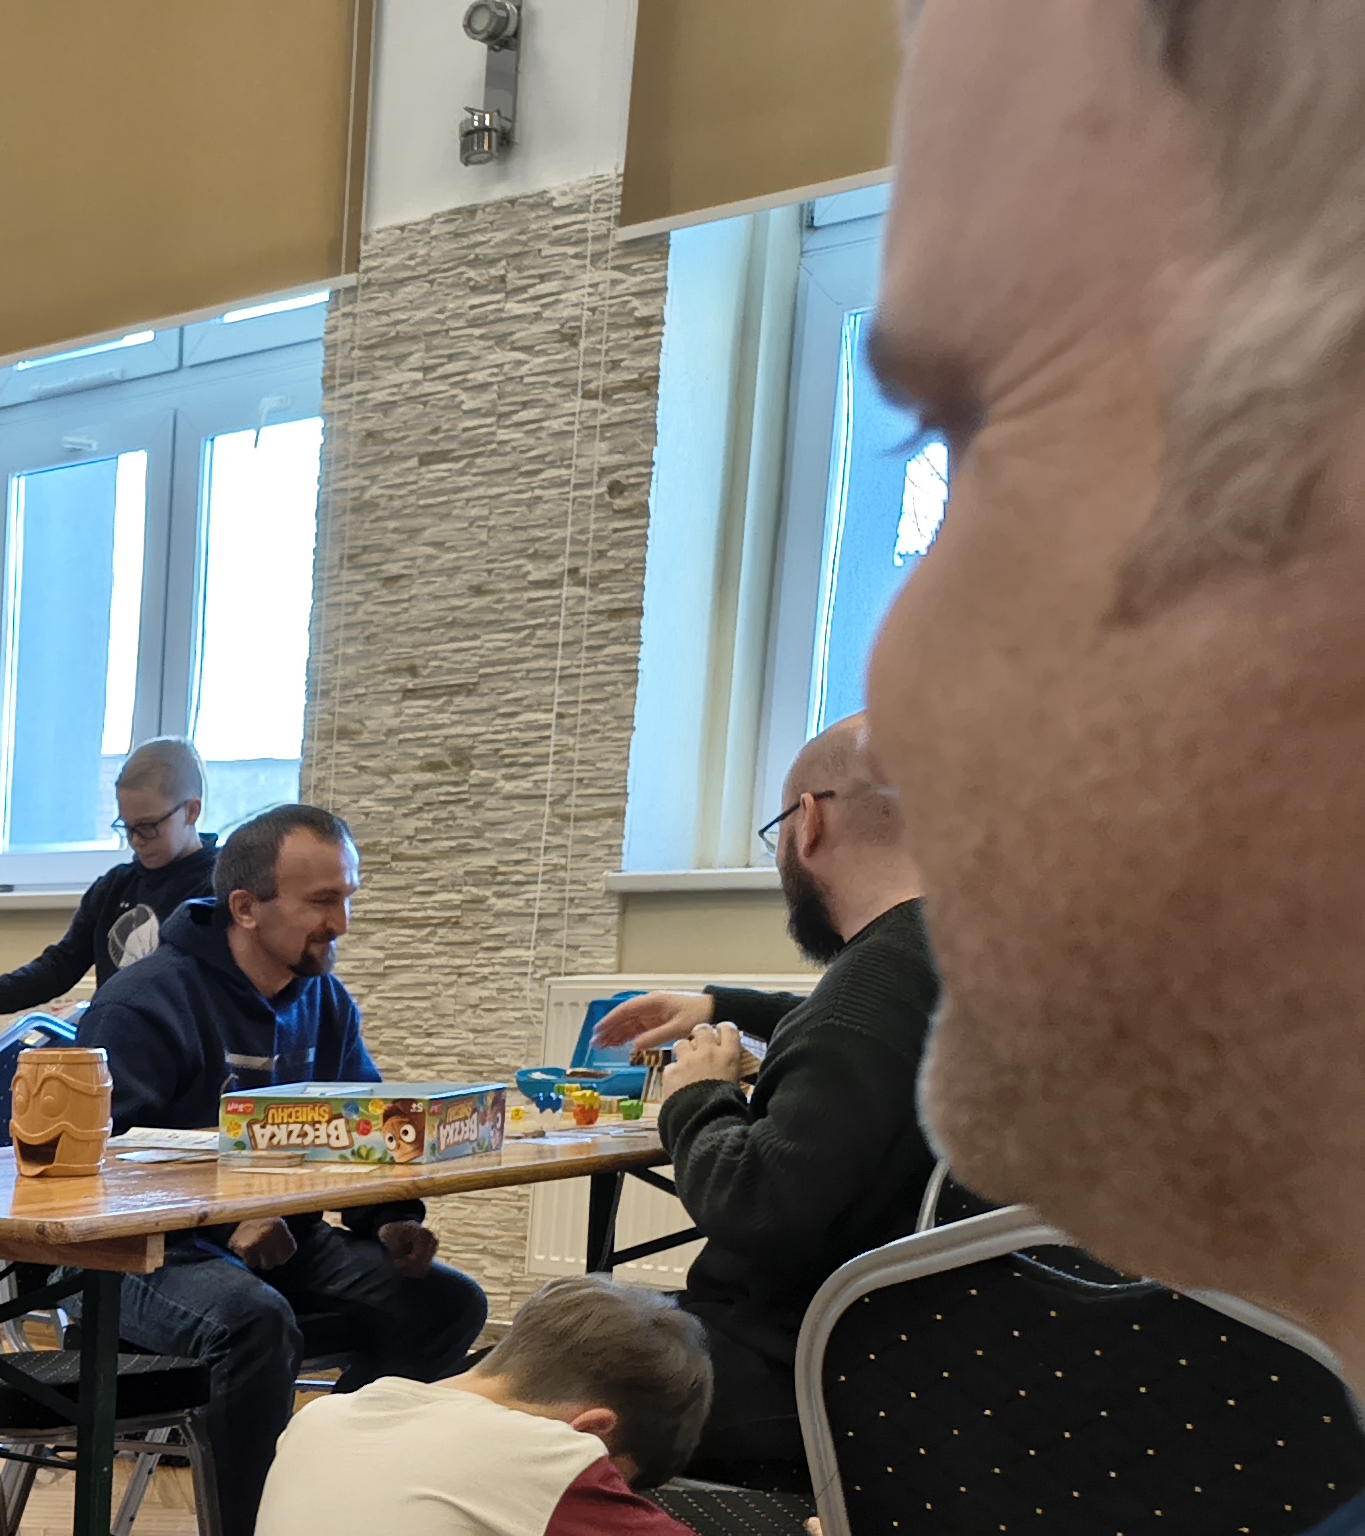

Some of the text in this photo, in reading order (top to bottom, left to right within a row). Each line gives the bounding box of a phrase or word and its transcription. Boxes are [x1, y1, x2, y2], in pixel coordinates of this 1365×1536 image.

[269, 1103, 331, 1124] ŚMIECHU
[252, 1116, 353, 1149] BECZKA
[438, 1111, 479, 1152] BECZKA
